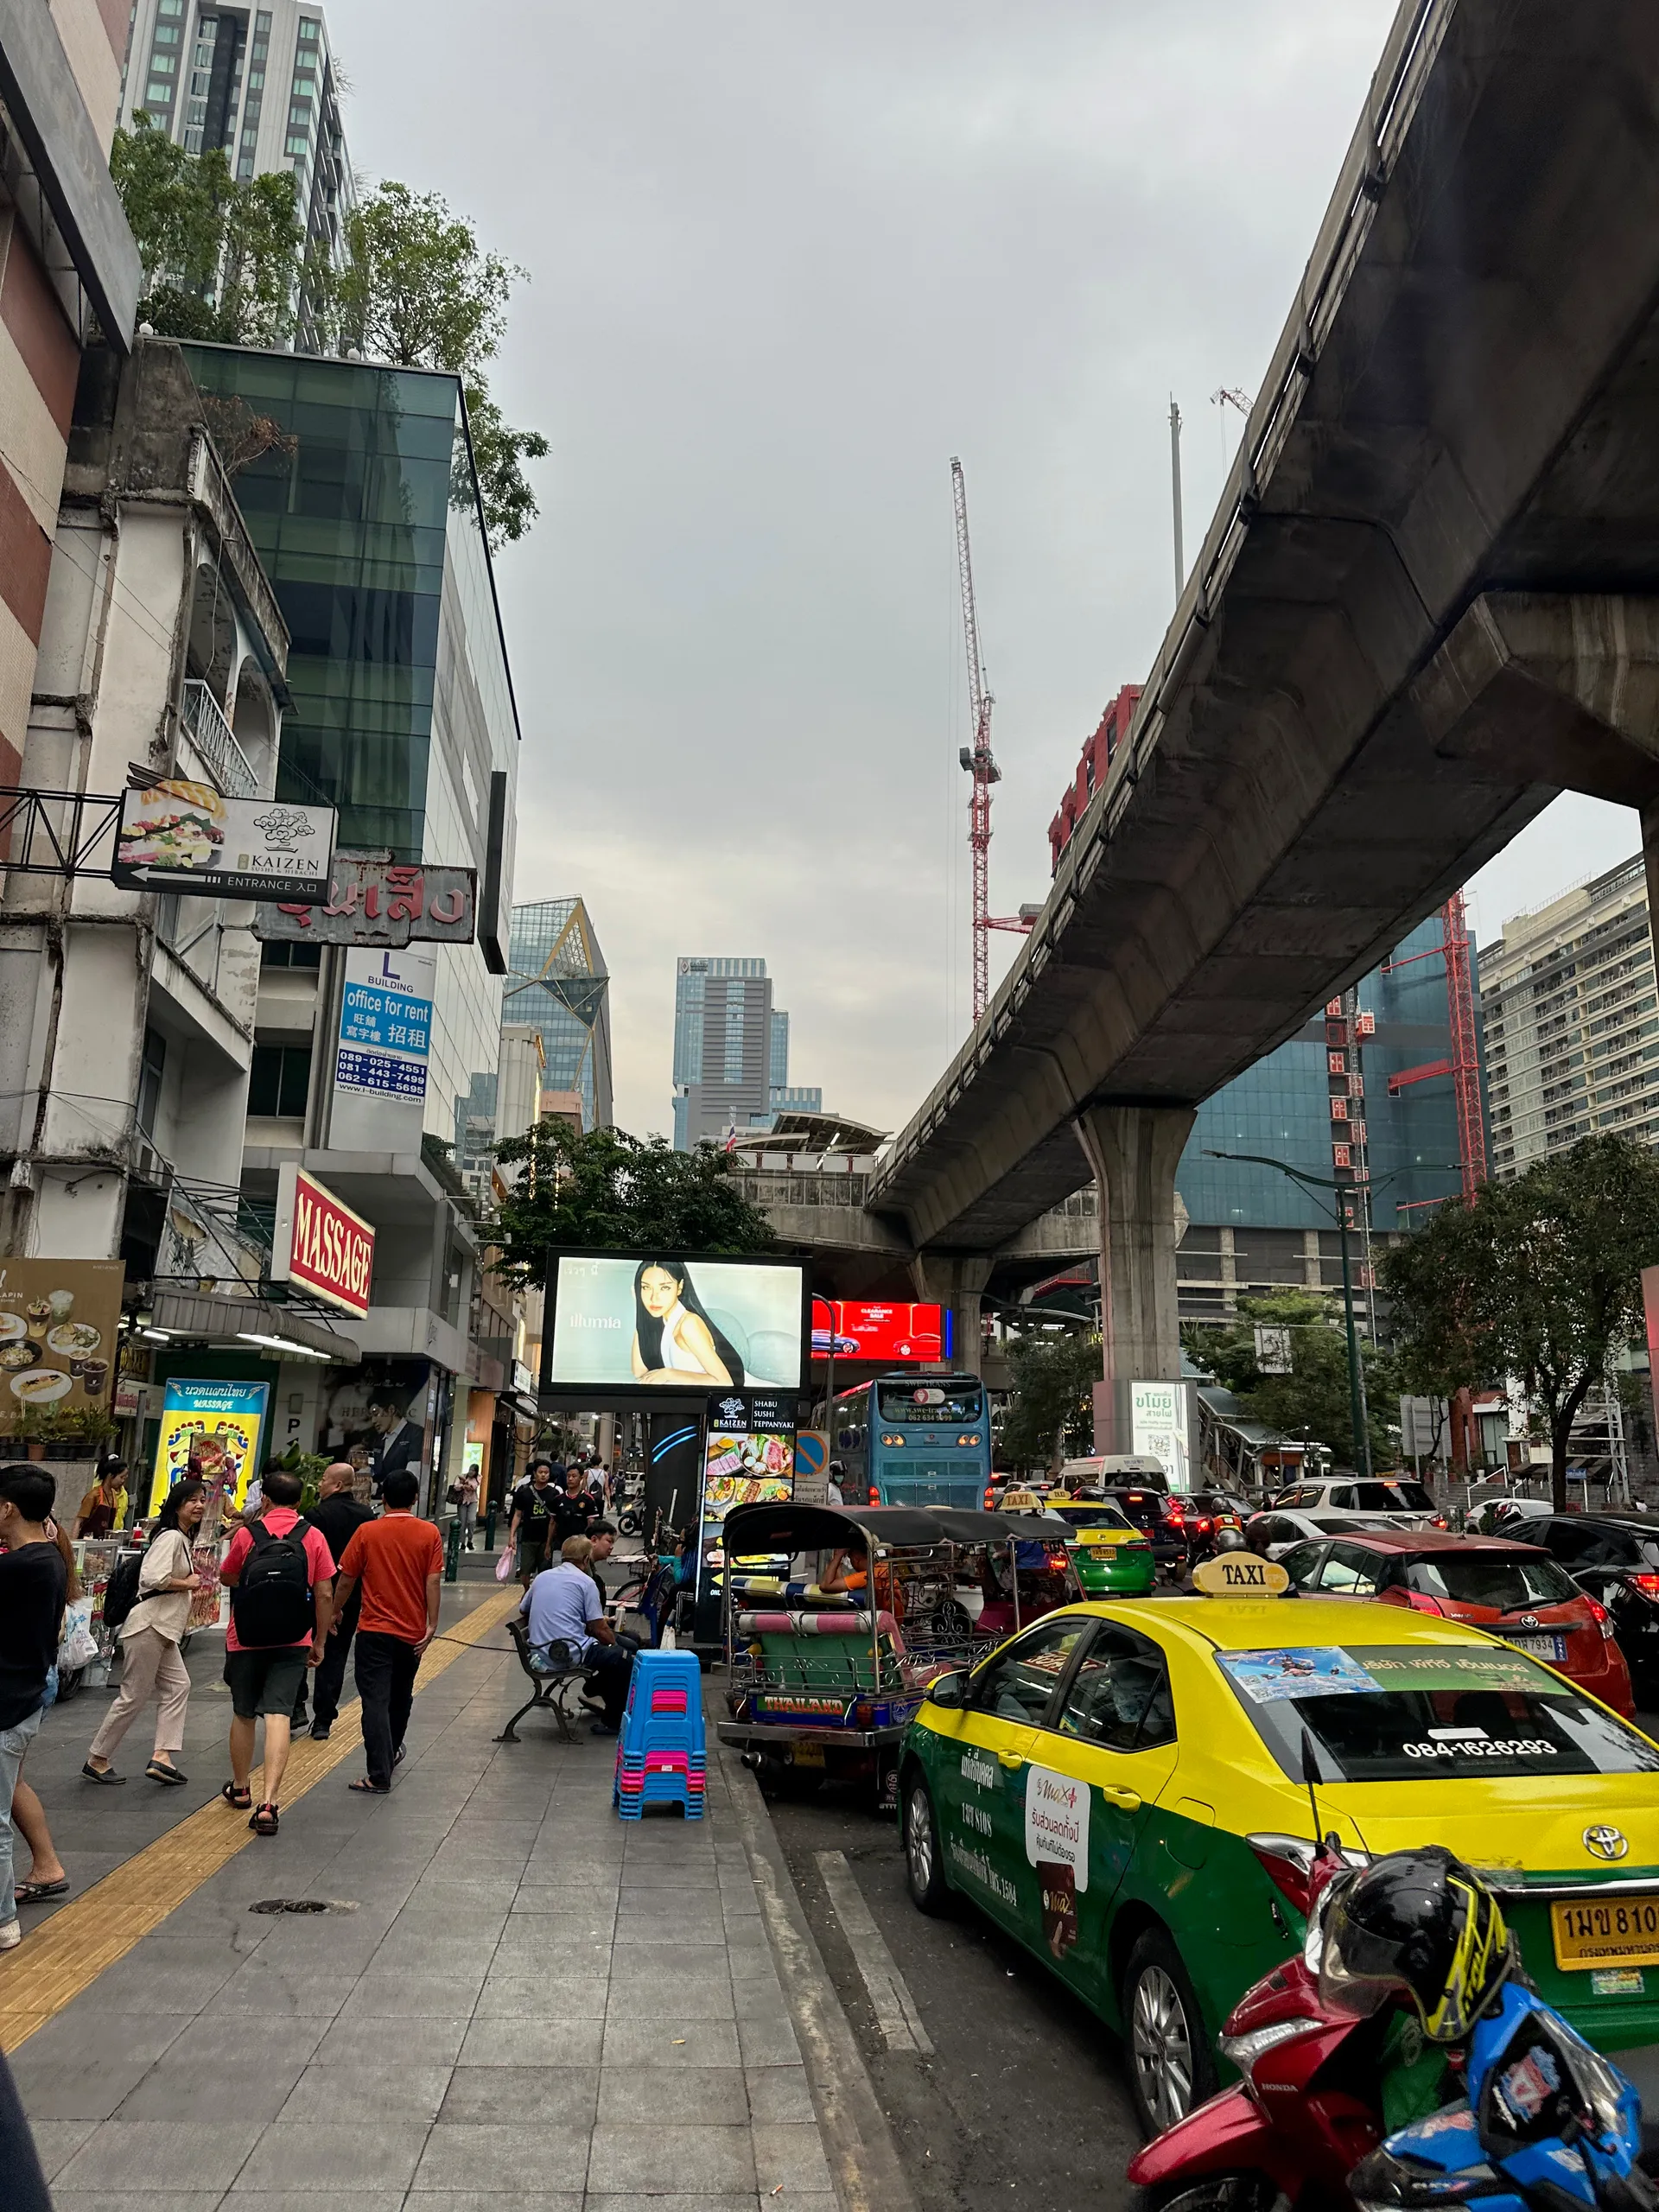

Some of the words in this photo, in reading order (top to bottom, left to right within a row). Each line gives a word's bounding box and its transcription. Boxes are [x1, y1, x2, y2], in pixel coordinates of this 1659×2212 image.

[251, 855, 319, 871] KAIZEN
[227, 876, 291, 891] ENTRANCE
[296, 882, 317, 893] 入口
[382, 950, 400, 981] L
[367, 976, 414, 994] BUILDING
[347, 988, 381, 1012] office
[385, 995, 403, 1016] for
[404, 1004, 429, 1022] rent
[388, 1023, 426, 1049] 招租
[340, 1052, 425, 1075] 089-025-4551
[339, 1062, 425, 1084] 081-443-7499
[338, 1071, 424, 1095] 062-615-5695
[293, 1192, 372, 1300] MASSAGE
[185, 1383, 247, 1397] นวดแผนไทย
[193, 1399, 234, 1411] MASSAGE
[1136, 1393, 1172, 1408] ขโมย
[287, 1418, 301, 1433] P
[753, 1420, 794, 1428] TEPPANYAKI
[1007, 1494, 1029, 1506] TAXI
[1222, 1565, 1266, 1585] TAXI
[1529, 1638, 1553, 1650] 7934
[764, 1696, 843, 1715] THAILAND
[975, 1807, 993, 1838] 8108
[1032, 1807, 1079, 1843] รับส่วนลดทั้งปี
[1564, 1907, 1611, 1937] 1มข
[1616, 1905, 1659, 1935] 810
[1262, 2082, 1299, 2092] HONDA
